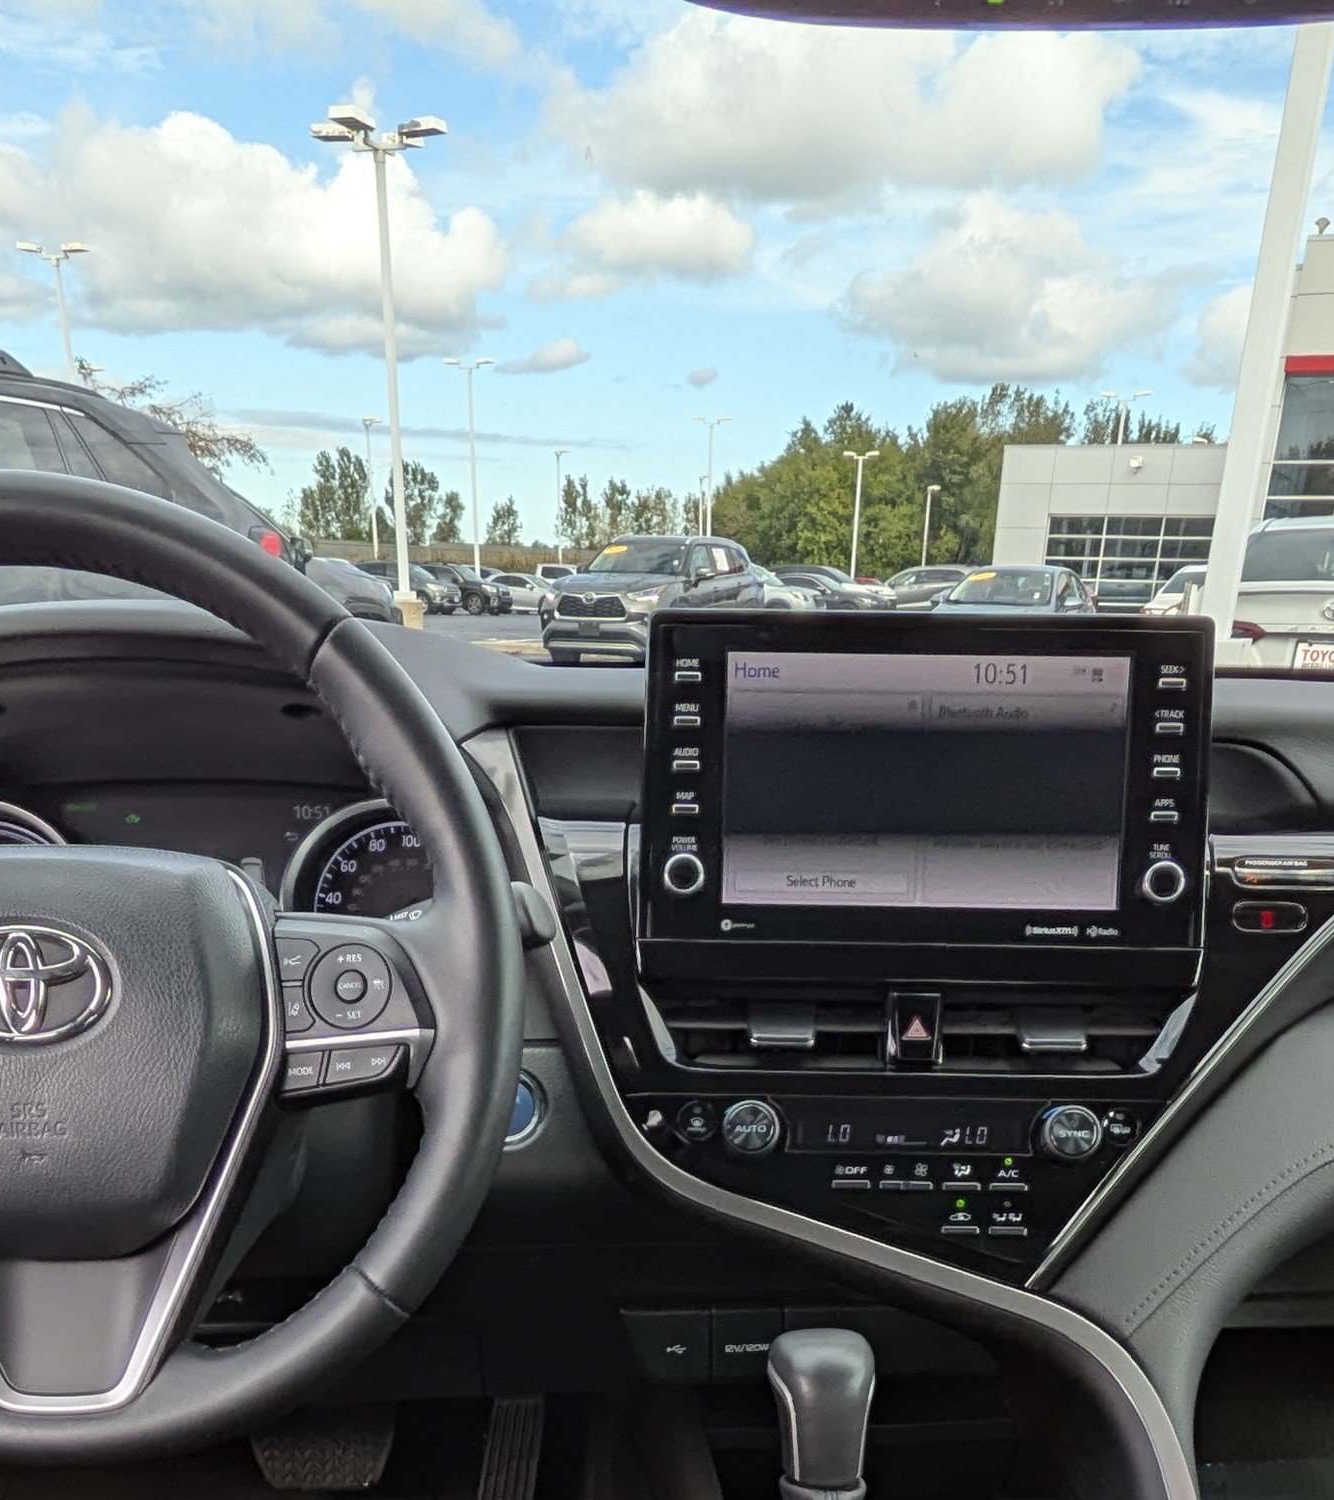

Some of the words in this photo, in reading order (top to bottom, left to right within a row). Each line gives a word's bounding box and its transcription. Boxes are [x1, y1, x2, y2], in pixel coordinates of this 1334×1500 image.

[676, 658, 700, 668] HOME
[734, 662, 780, 678] Home
[974, 663, 1027, 685] 10:51
[675, 703, 699, 712] MENU
[674, 747, 699, 756] AUDIO
[1153, 754, 1180, 763] PHONE
[676, 791, 695, 800] MAP
[1154, 799, 1175, 807] APPS
[293, 804, 330, 820] 10:51
[368, 839, 386, 851] 80
[340, 860, 357, 873] 60
[786, 874, 819, 888] Select
[822, 875, 856, 888] Phone
[325, 892, 341, 904] 40
[346, 954, 362, 963] RES
[347, 1010, 362, 1019] SET
[289, 1066, 314, 1076] MODE
[11, 1103, 47, 1120] SRS
[734, 1125, 767, 1133] AUTO
[1058, 1129, 1089, 1139] SYNC
[845, 1166, 868, 1175] OFF
[998, 1169, 1019, 1178] A/C
